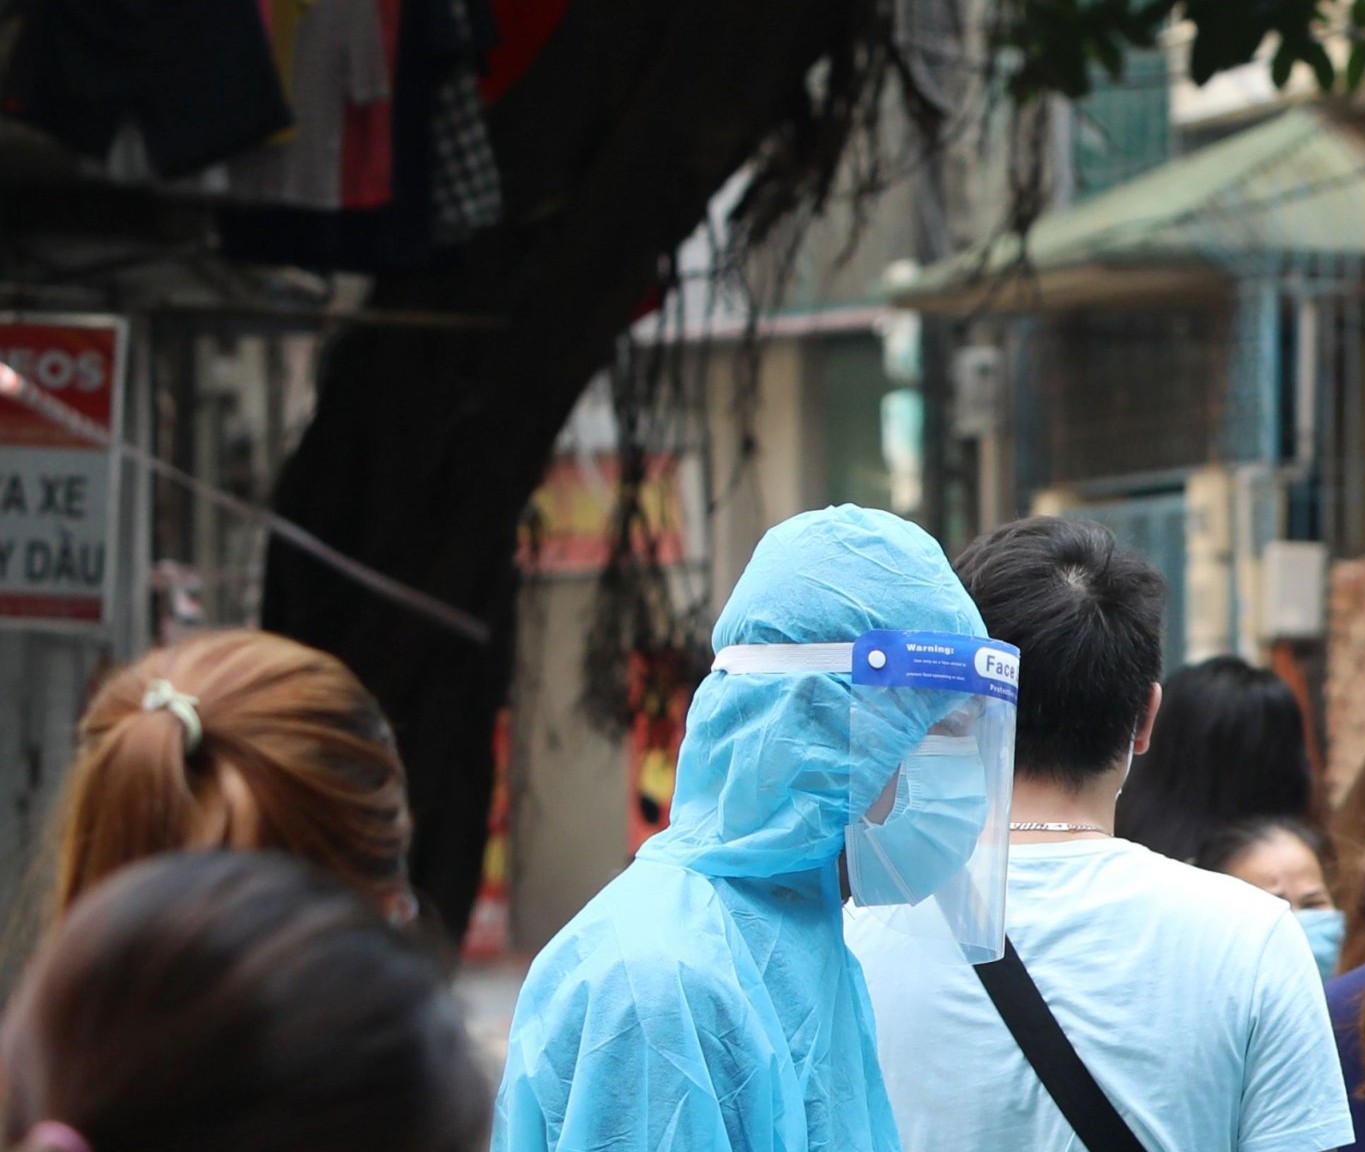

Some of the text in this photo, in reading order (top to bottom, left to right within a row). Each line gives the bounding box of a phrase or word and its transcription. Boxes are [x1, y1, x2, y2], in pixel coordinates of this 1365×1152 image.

[0, 347, 105, 392] EOS
[37, 475, 88, 519] XE
[906, 643, 954, 656] Warning:
[985, 654, 1015, 680] Face
